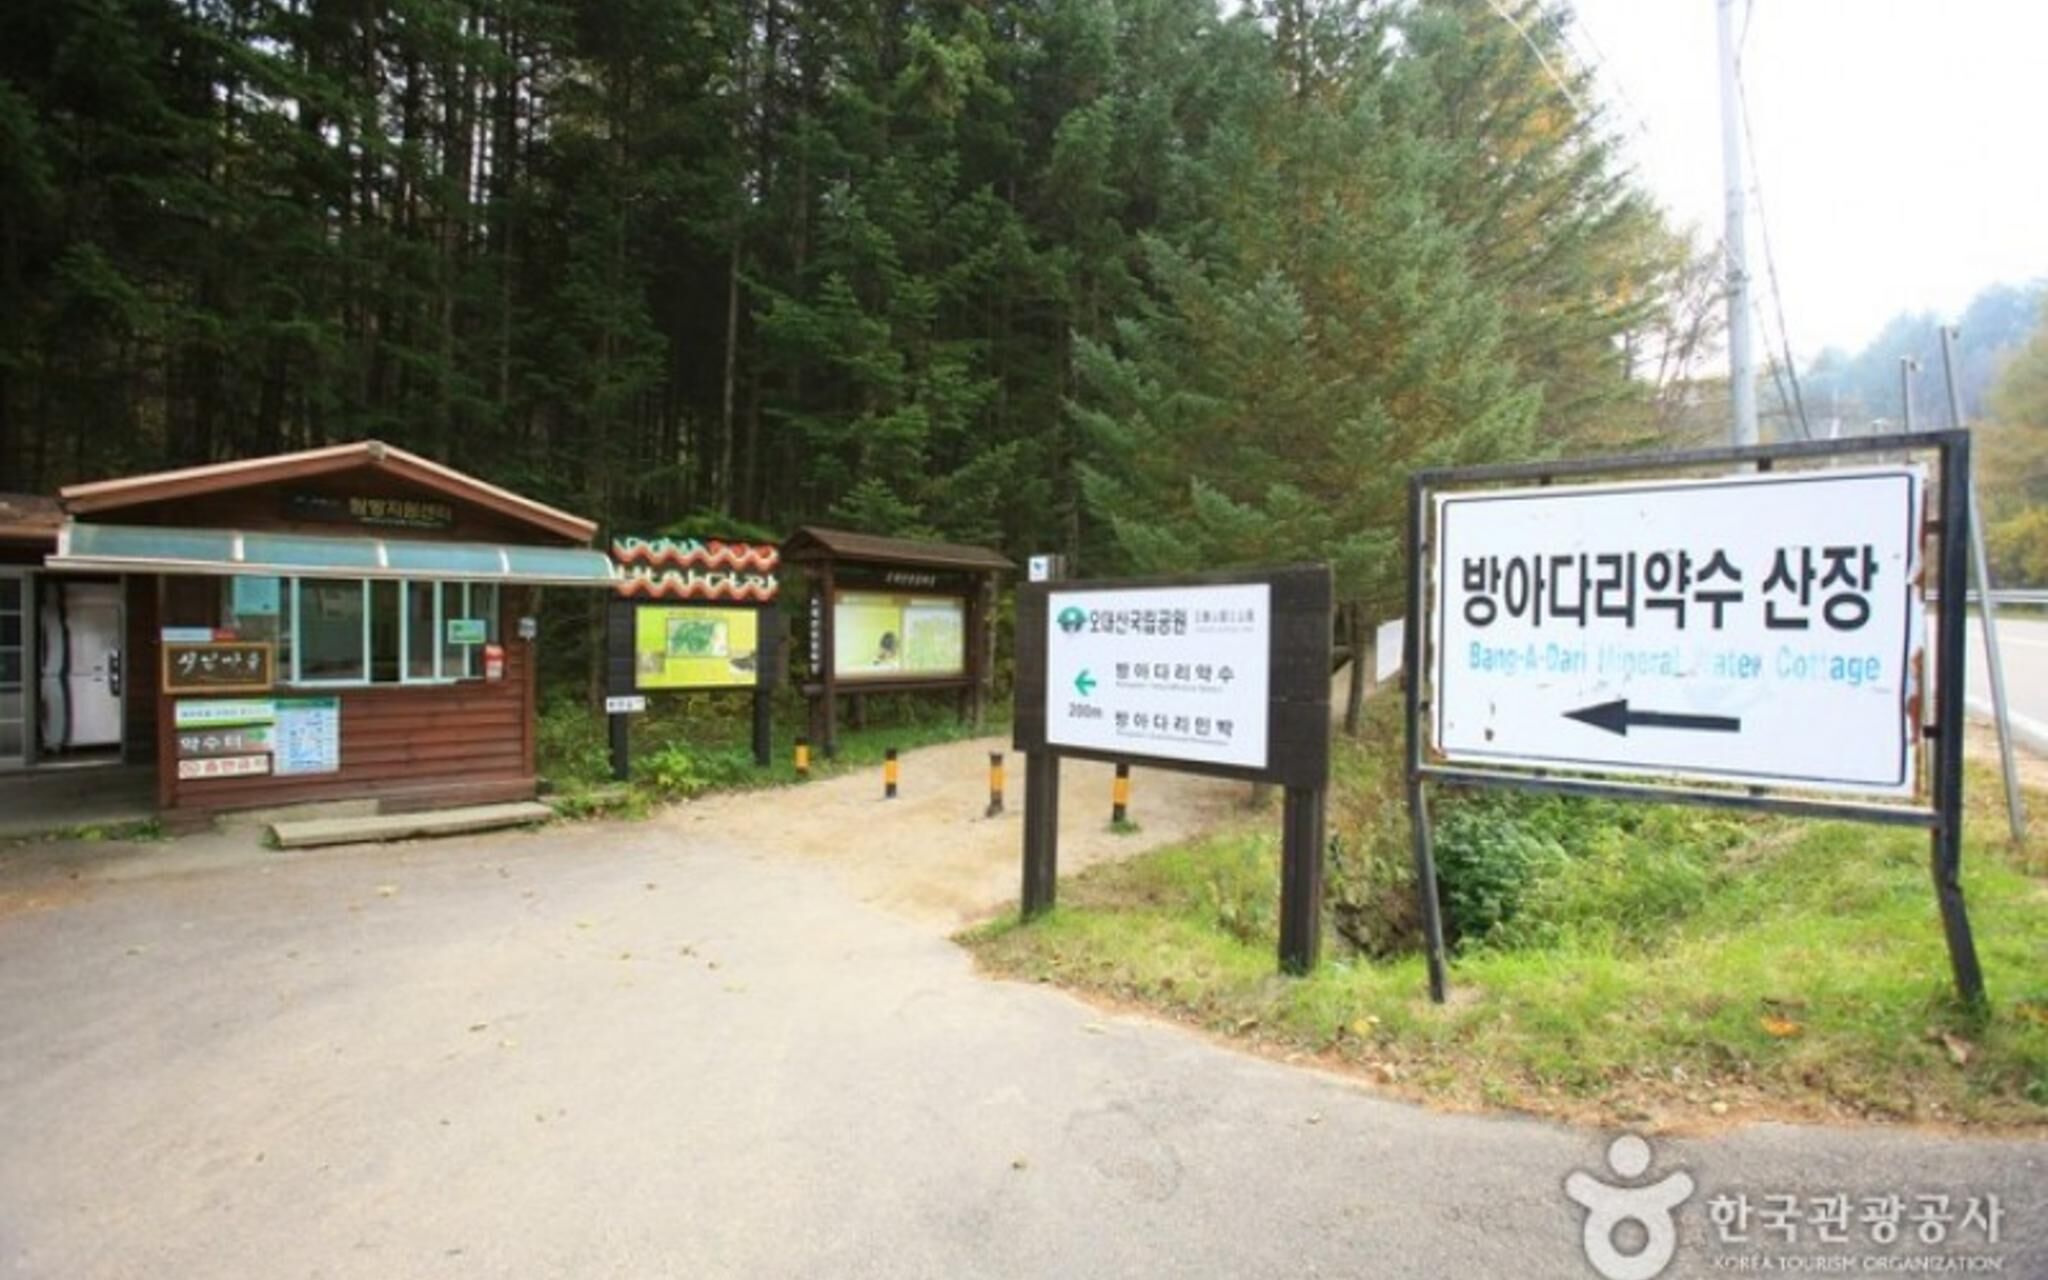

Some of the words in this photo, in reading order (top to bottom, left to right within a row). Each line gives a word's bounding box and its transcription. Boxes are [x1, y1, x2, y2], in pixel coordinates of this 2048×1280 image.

[1462, 549, 1743, 629] 방아다리약수
[1762, 545, 1879, 632] 산장
[1090, 609, 1187, 636] 오대산국립공원
[1115, 662, 1235, 683] 방아다리약수
[180, 735, 242, 751] 약수터
